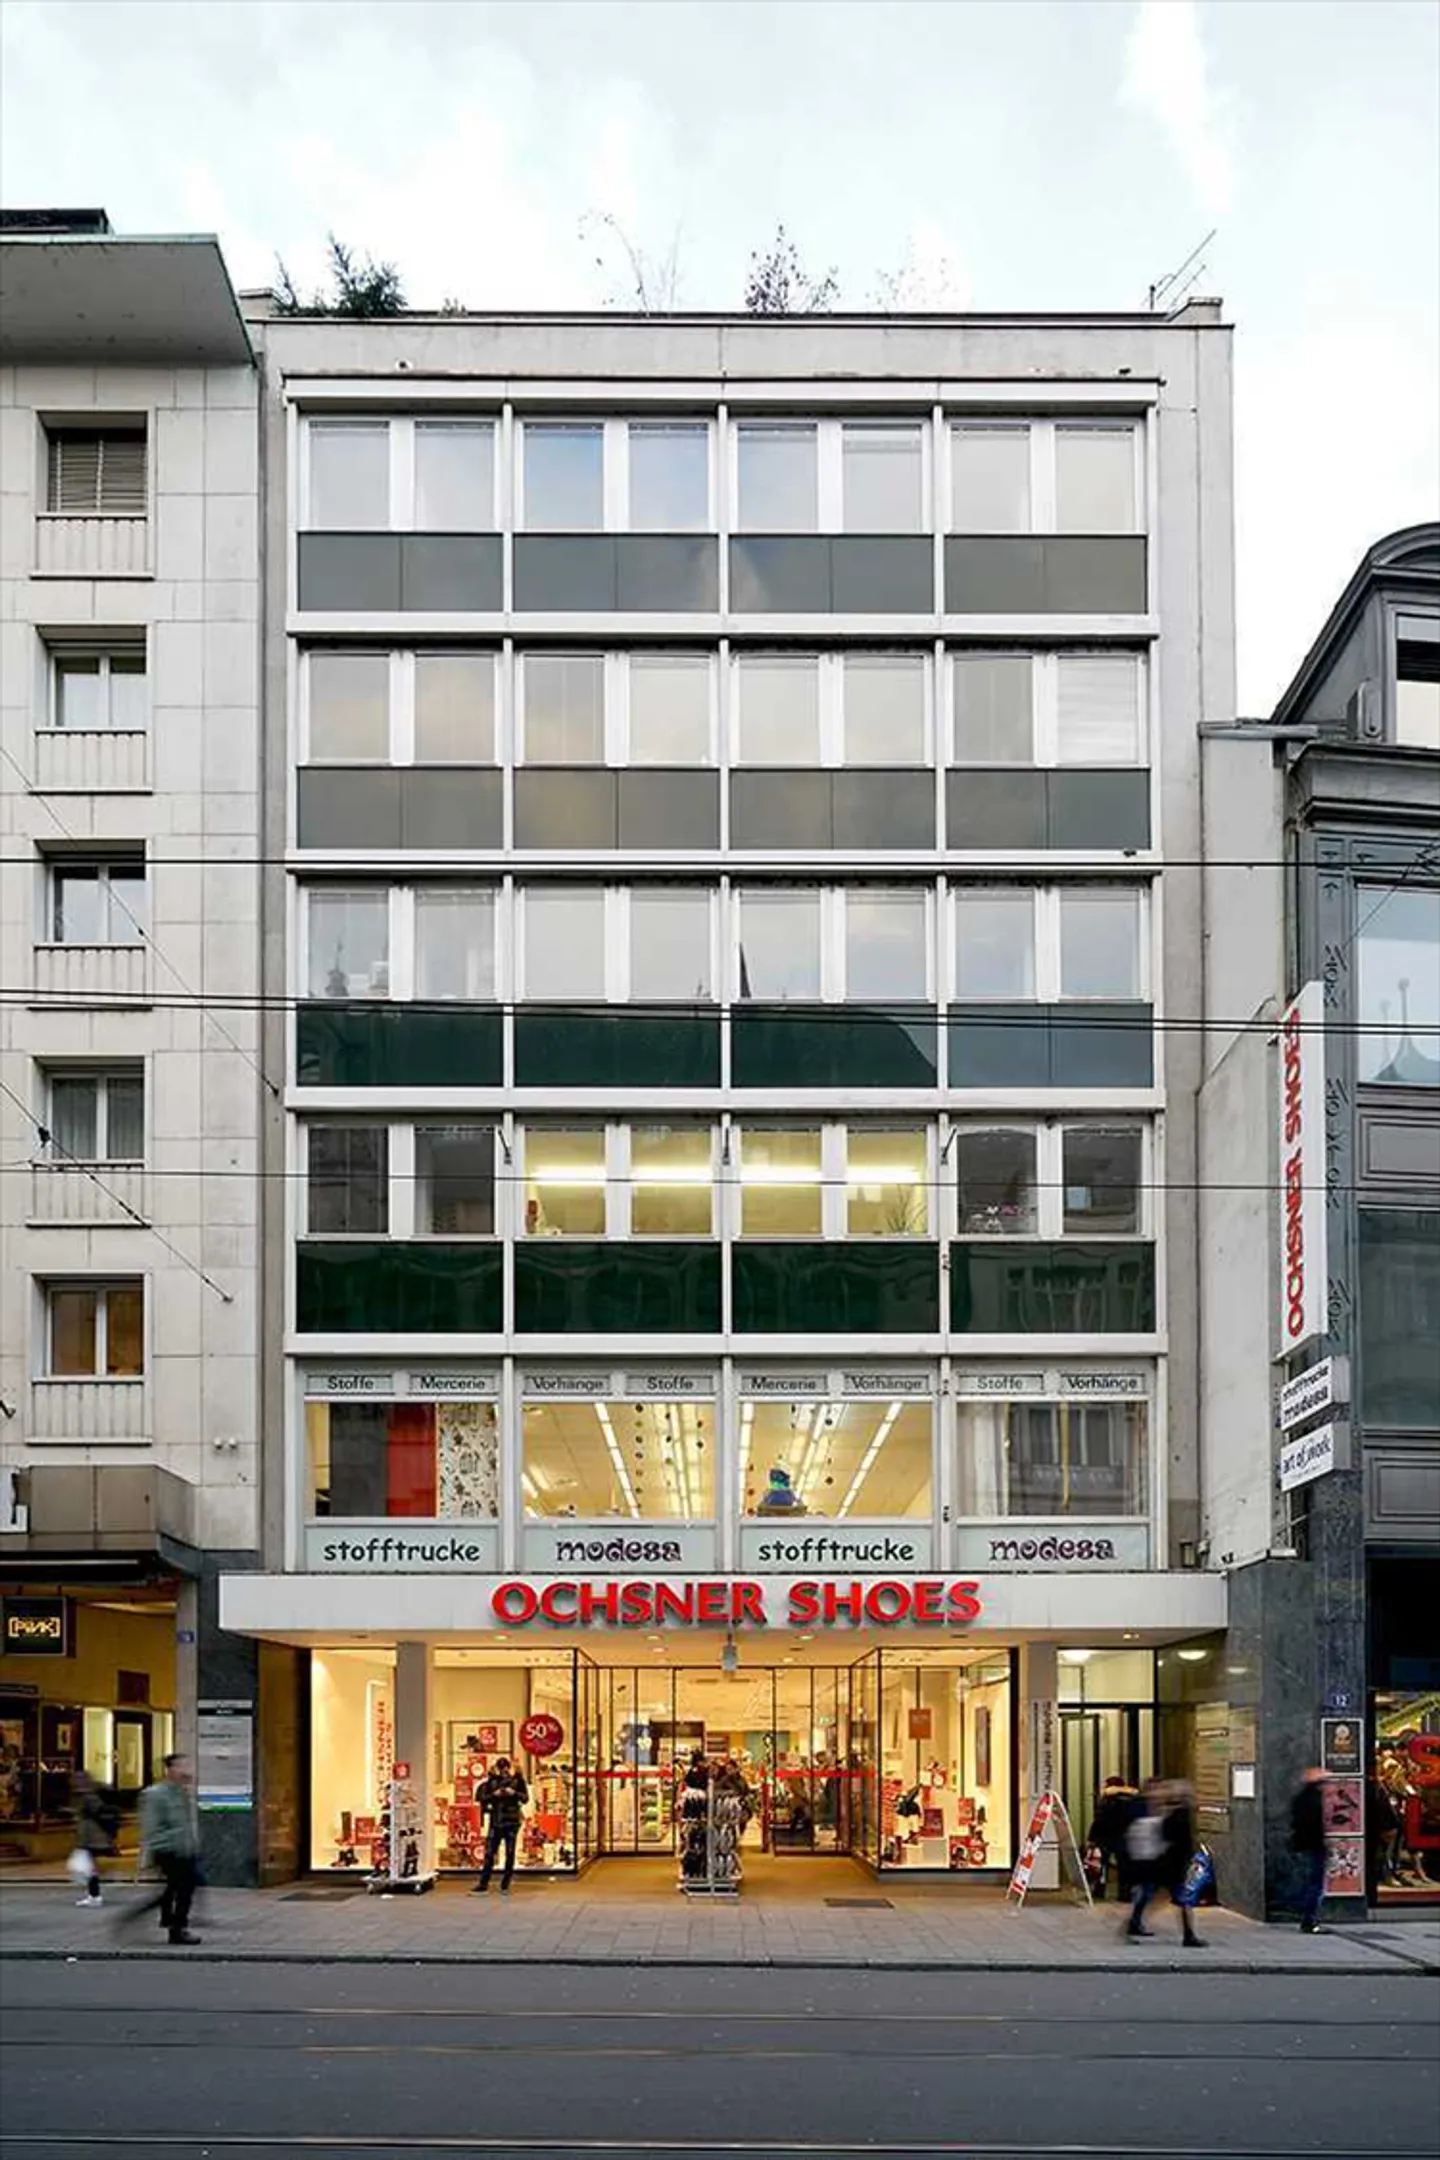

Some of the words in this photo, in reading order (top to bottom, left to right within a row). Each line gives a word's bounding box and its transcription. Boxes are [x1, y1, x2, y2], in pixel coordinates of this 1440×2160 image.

[1283, 1009, 1302, 1144] SHOES
[1284, 1148, 1304, 1337] OCHSNER
[328, 1375, 374, 1390] Stoffe
[647, 1375, 693, 1390] Stoffe
[977, 1375, 1023, 1390] Stoffe
[324, 1538, 480, 1561] stofftrucke
[758, 1538, 914, 1561] stofftrucke
[491, 1582, 768, 1625] OCHSNER
[787, 1581, 982, 1624] SHOES
